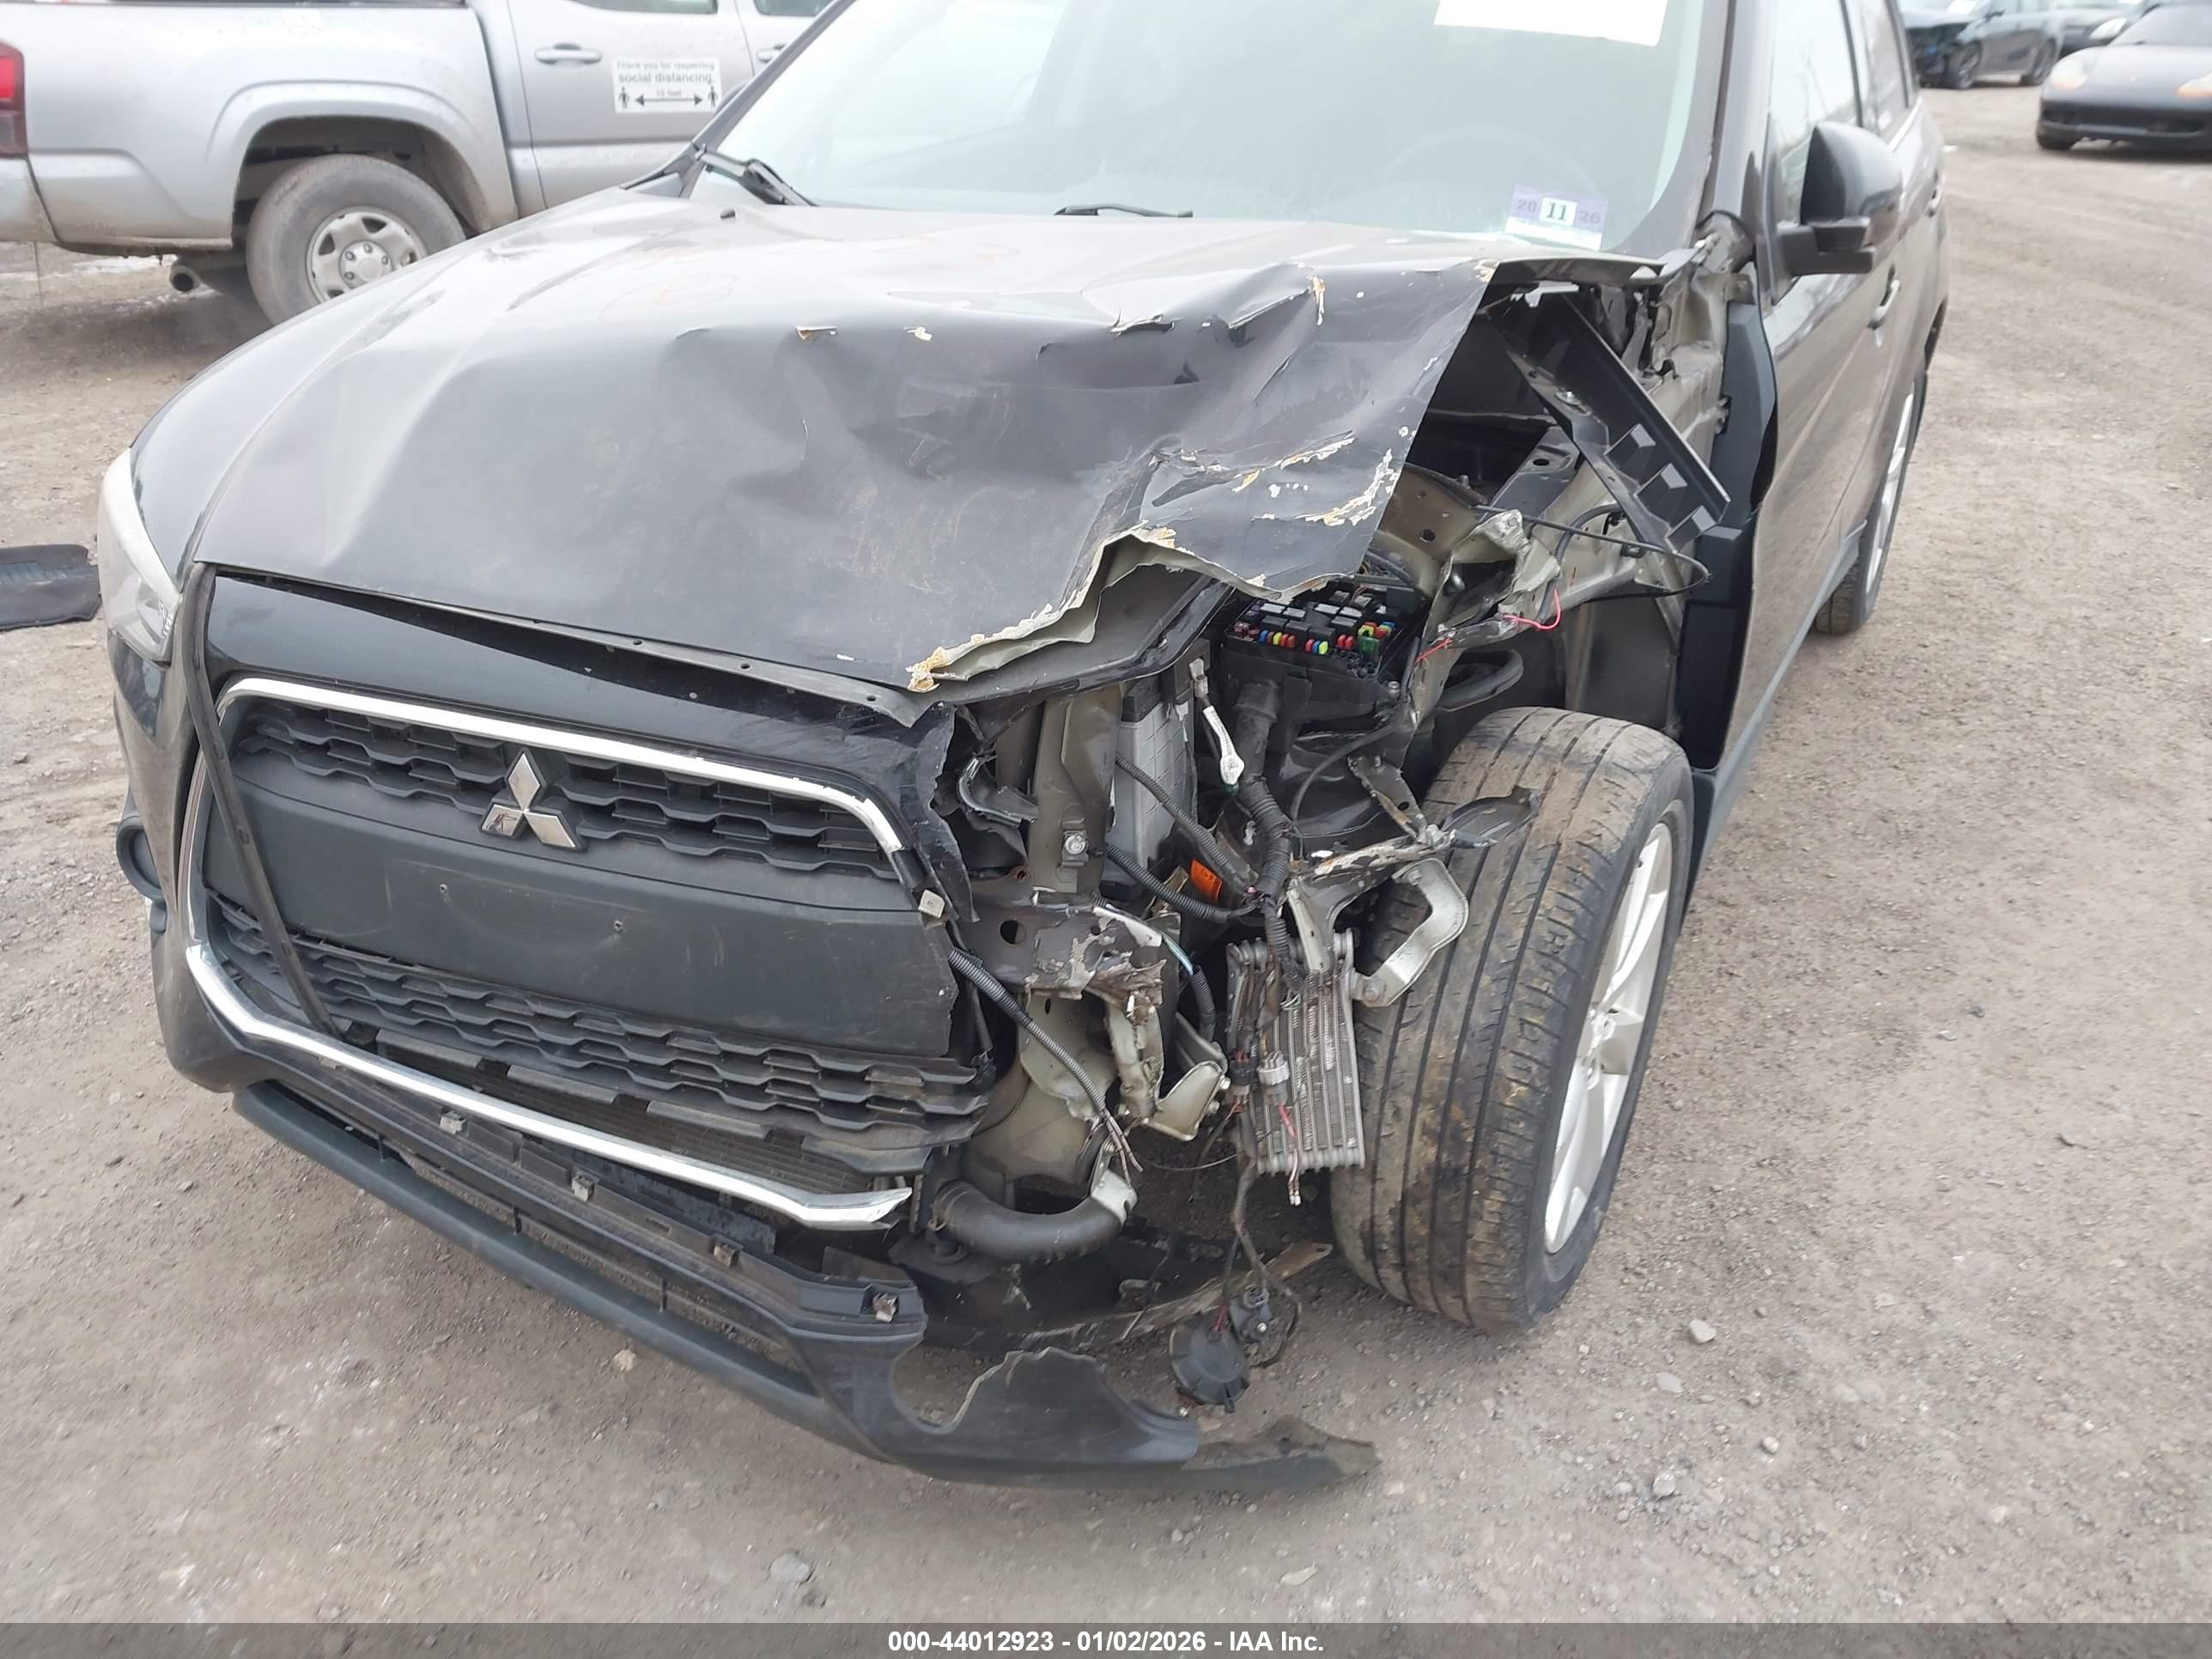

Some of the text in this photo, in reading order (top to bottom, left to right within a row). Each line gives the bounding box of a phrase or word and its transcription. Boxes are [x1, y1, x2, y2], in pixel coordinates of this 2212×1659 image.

[643, 63, 659, 71] you
[672, 61, 714, 71] respecting
[618, 72, 652, 83] social
[1517, 198, 1602, 224] 20 11 26
